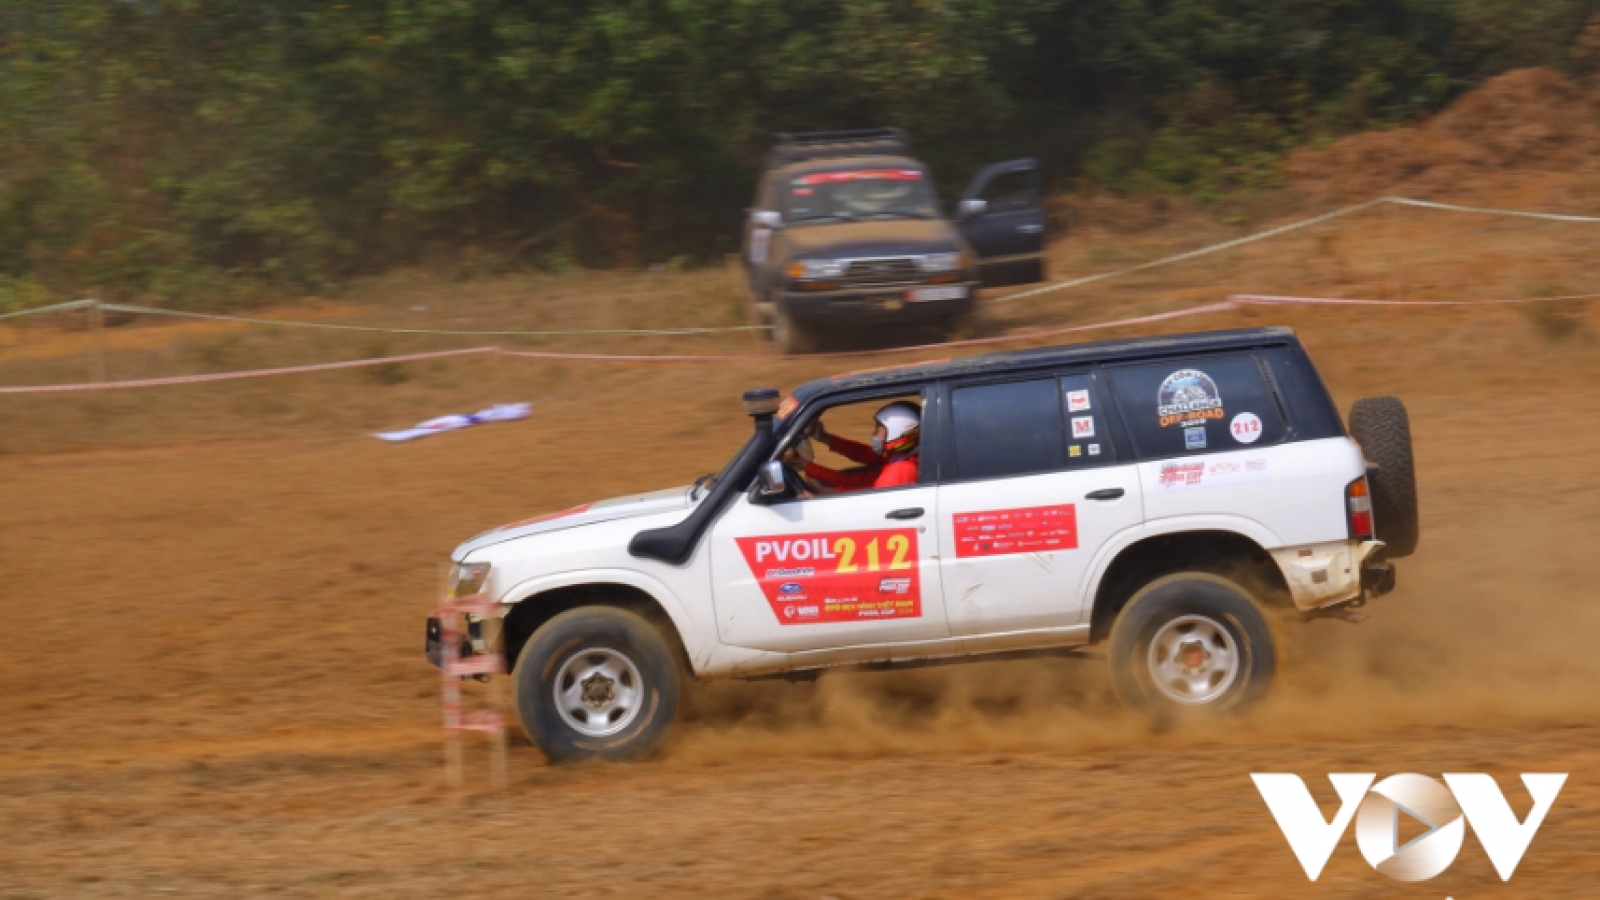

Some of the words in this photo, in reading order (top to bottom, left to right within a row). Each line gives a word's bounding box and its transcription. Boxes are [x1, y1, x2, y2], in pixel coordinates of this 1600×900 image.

[1233, 420, 1259, 434] 212
[755, 538, 836, 562] PVOIL
[833, 534, 912, 574] 212
